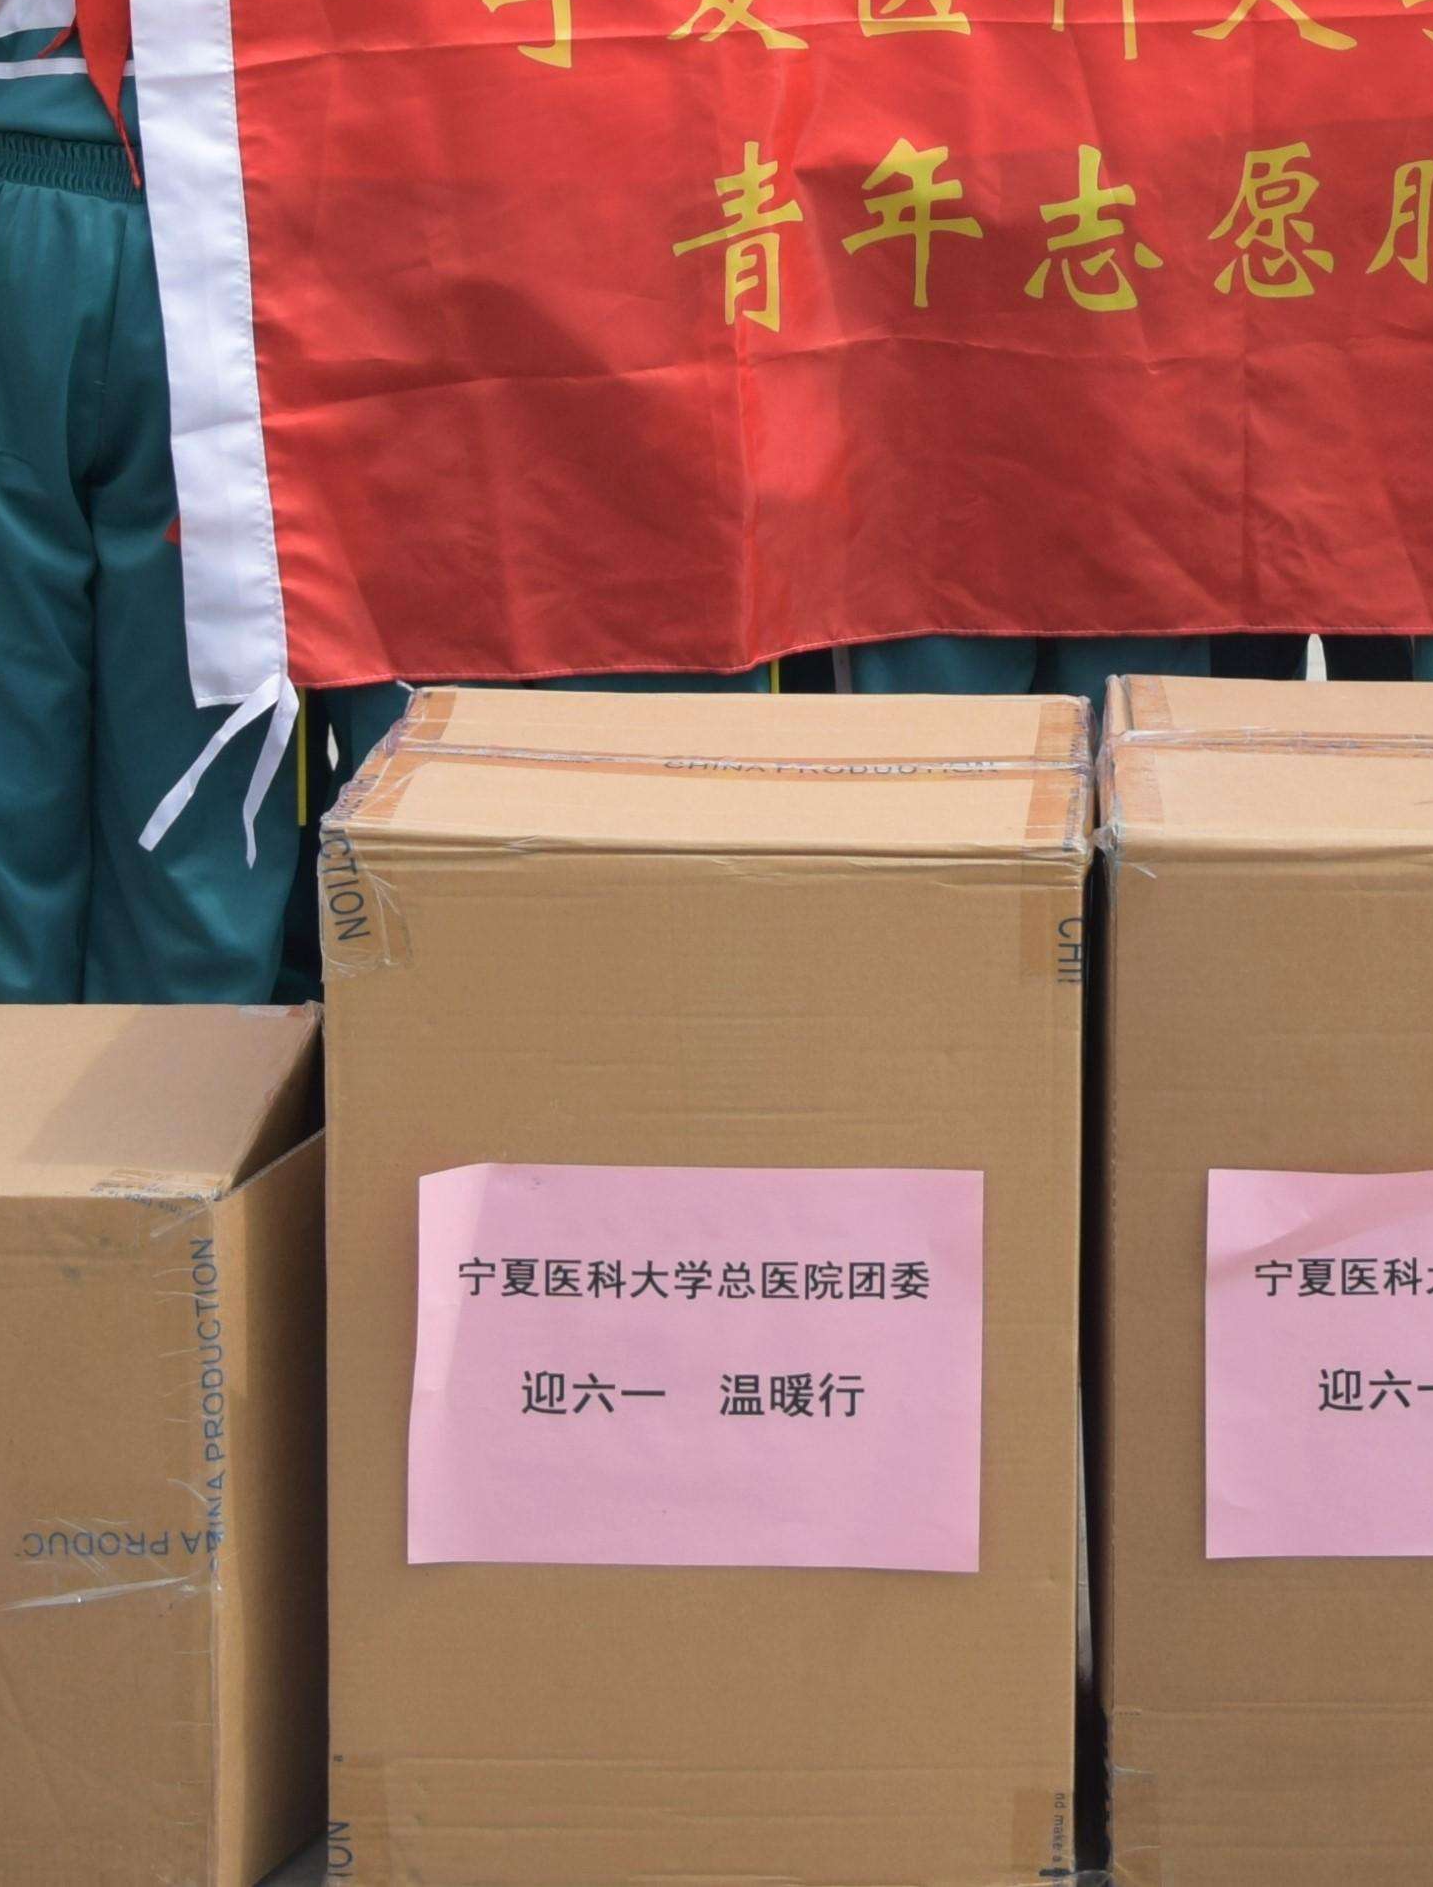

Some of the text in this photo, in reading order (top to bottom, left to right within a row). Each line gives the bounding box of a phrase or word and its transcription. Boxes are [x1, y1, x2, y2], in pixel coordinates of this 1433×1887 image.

[458, 1256, 930, 1301] 宁夏医科大学总医院团委
[189, 1237, 226, 1462] PRODUCTION
[521, 1370, 865, 1418] 迎六一 温暖行
